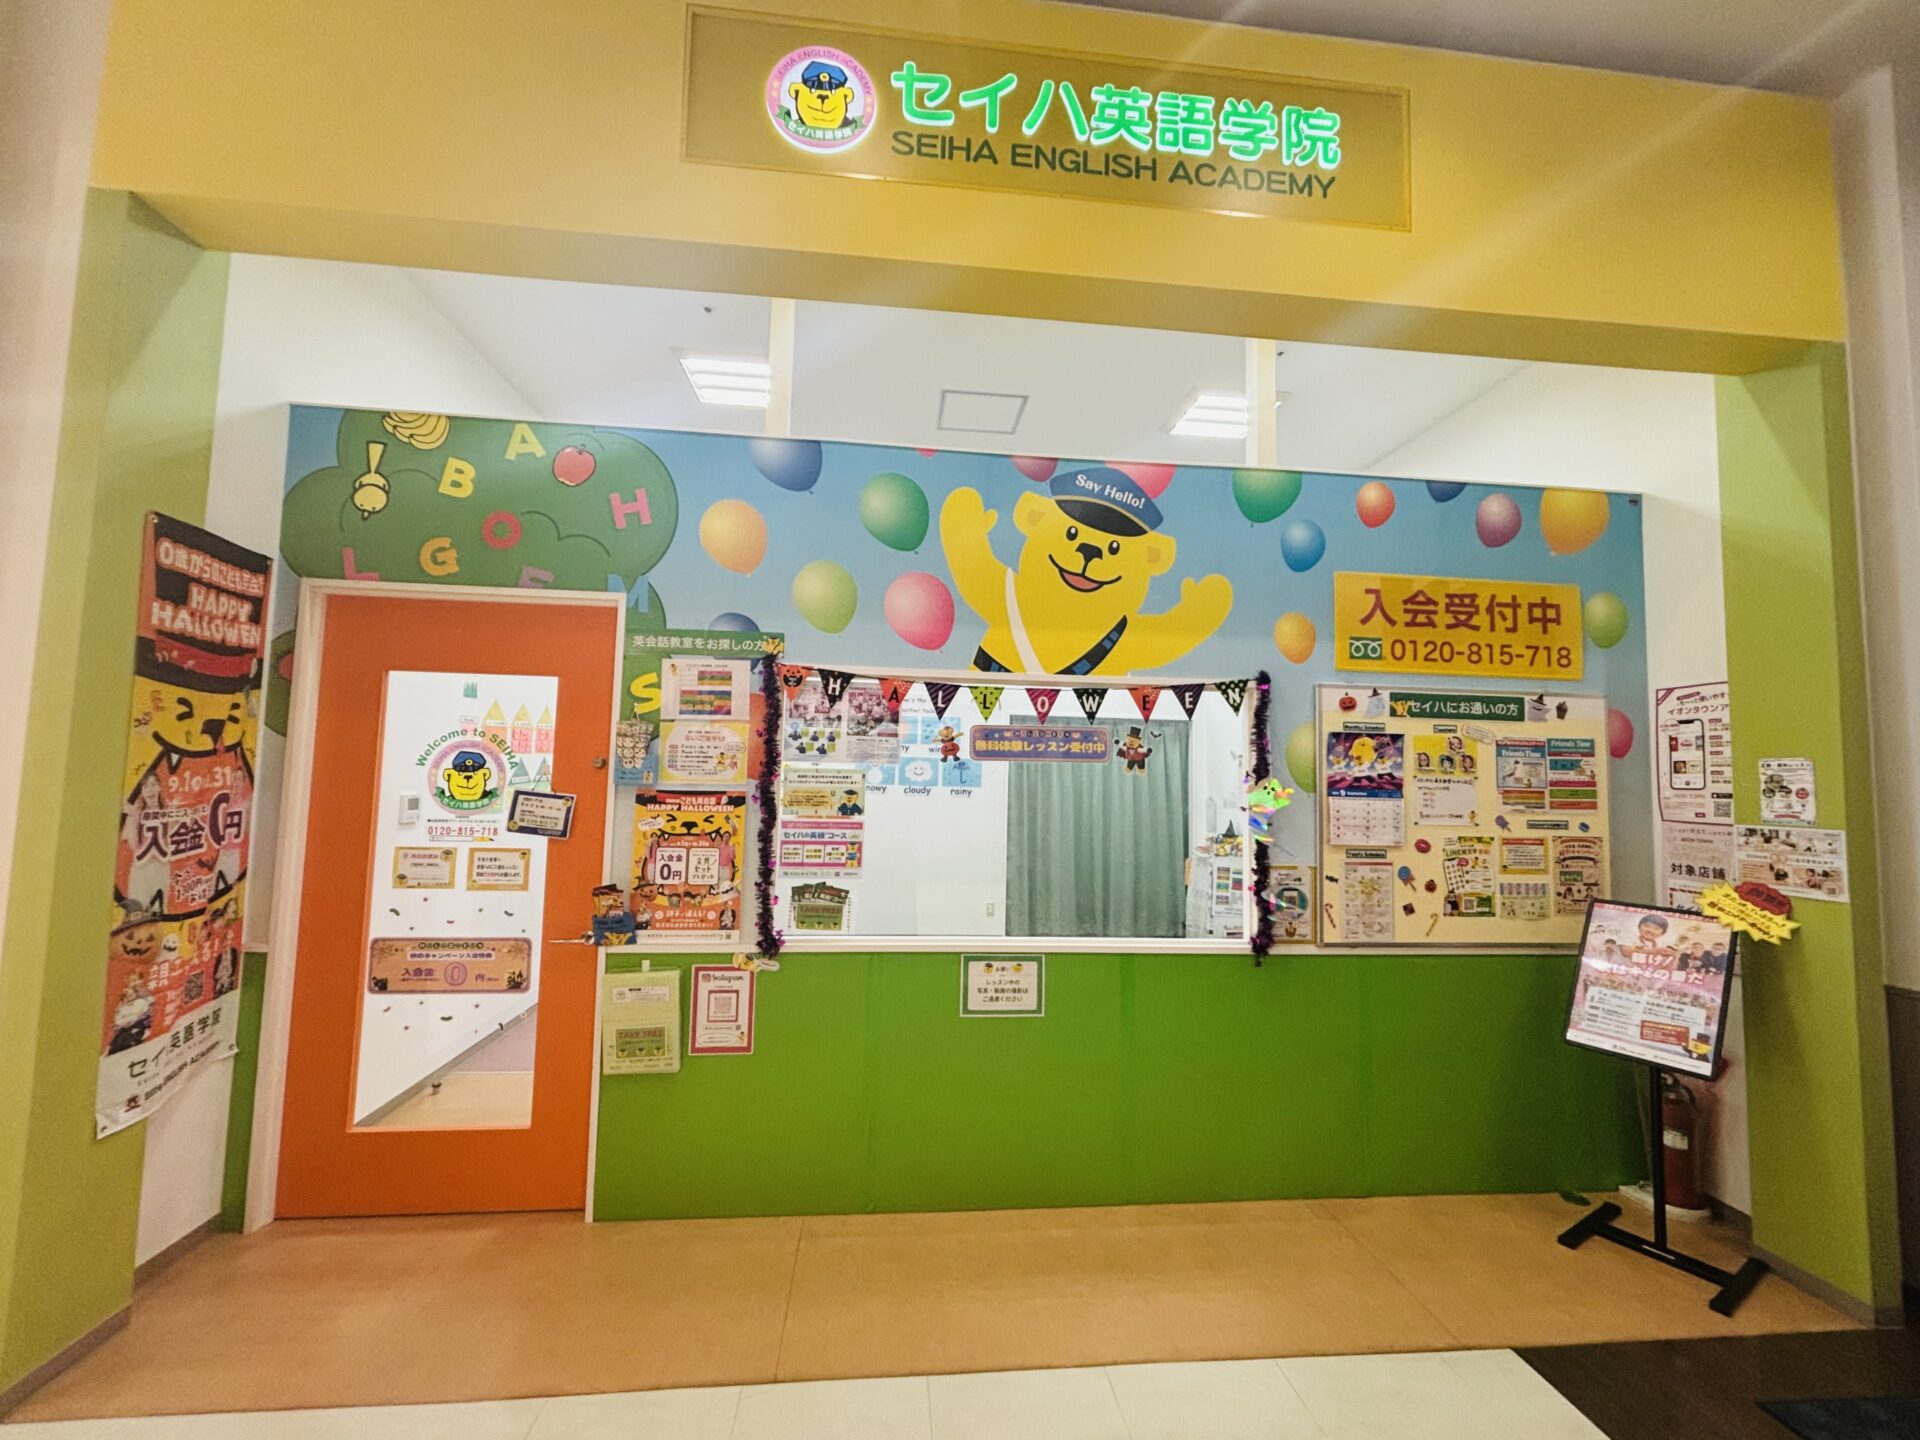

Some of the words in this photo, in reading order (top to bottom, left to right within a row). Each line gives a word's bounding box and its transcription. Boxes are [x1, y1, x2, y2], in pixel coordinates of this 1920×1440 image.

[891, 61, 1341, 169] セイハ英語学院
[891, 130, 999, 165] SEIHA
[1010, 143, 1157, 182] ENGLISH
[1168, 161, 1336, 199] ACADEMY
[505, 423, 545, 461] A
[438, 457, 476, 498] B
[1075, 474, 1102, 494] Say
[1105, 485, 1145, 509] Hello!
[609, 488, 651, 529] H
[481, 511, 522, 550] O
[419, 537, 460, 577] G
[190, 585, 250, 622] HAPPY
[1359, 588, 1562, 635] 入会受付中
[633, 636, 764, 651] 英会話教室をお探しの方
[1390, 639, 1572, 668] 0120-815-718
[630, 672, 661, 715] S
[1410, 699, 1519, 716] セイハにお通いの方
[416, 727, 468, 767] Welcome
[472, 727, 486, 738] to
[489, 733, 520, 770] SEIHA
[975, 740, 1105, 754] 無料体験レッスン受付中
[904, 786, 931, 796] cloudy
[950, 789, 972, 798] rainy
[681, 804, 734, 812] HALLOWEEN
[427, 825, 498, 837] 0120-815-718
[659, 853, 683, 862] 入会金
[660, 863, 682, 881] 0円
[1670, 863, 1726, 880] 対象店舗
[401, 967, 434, 978] 入会金
[475, 973, 485, 982] 円
[711, 973, 744, 984] Instagram
